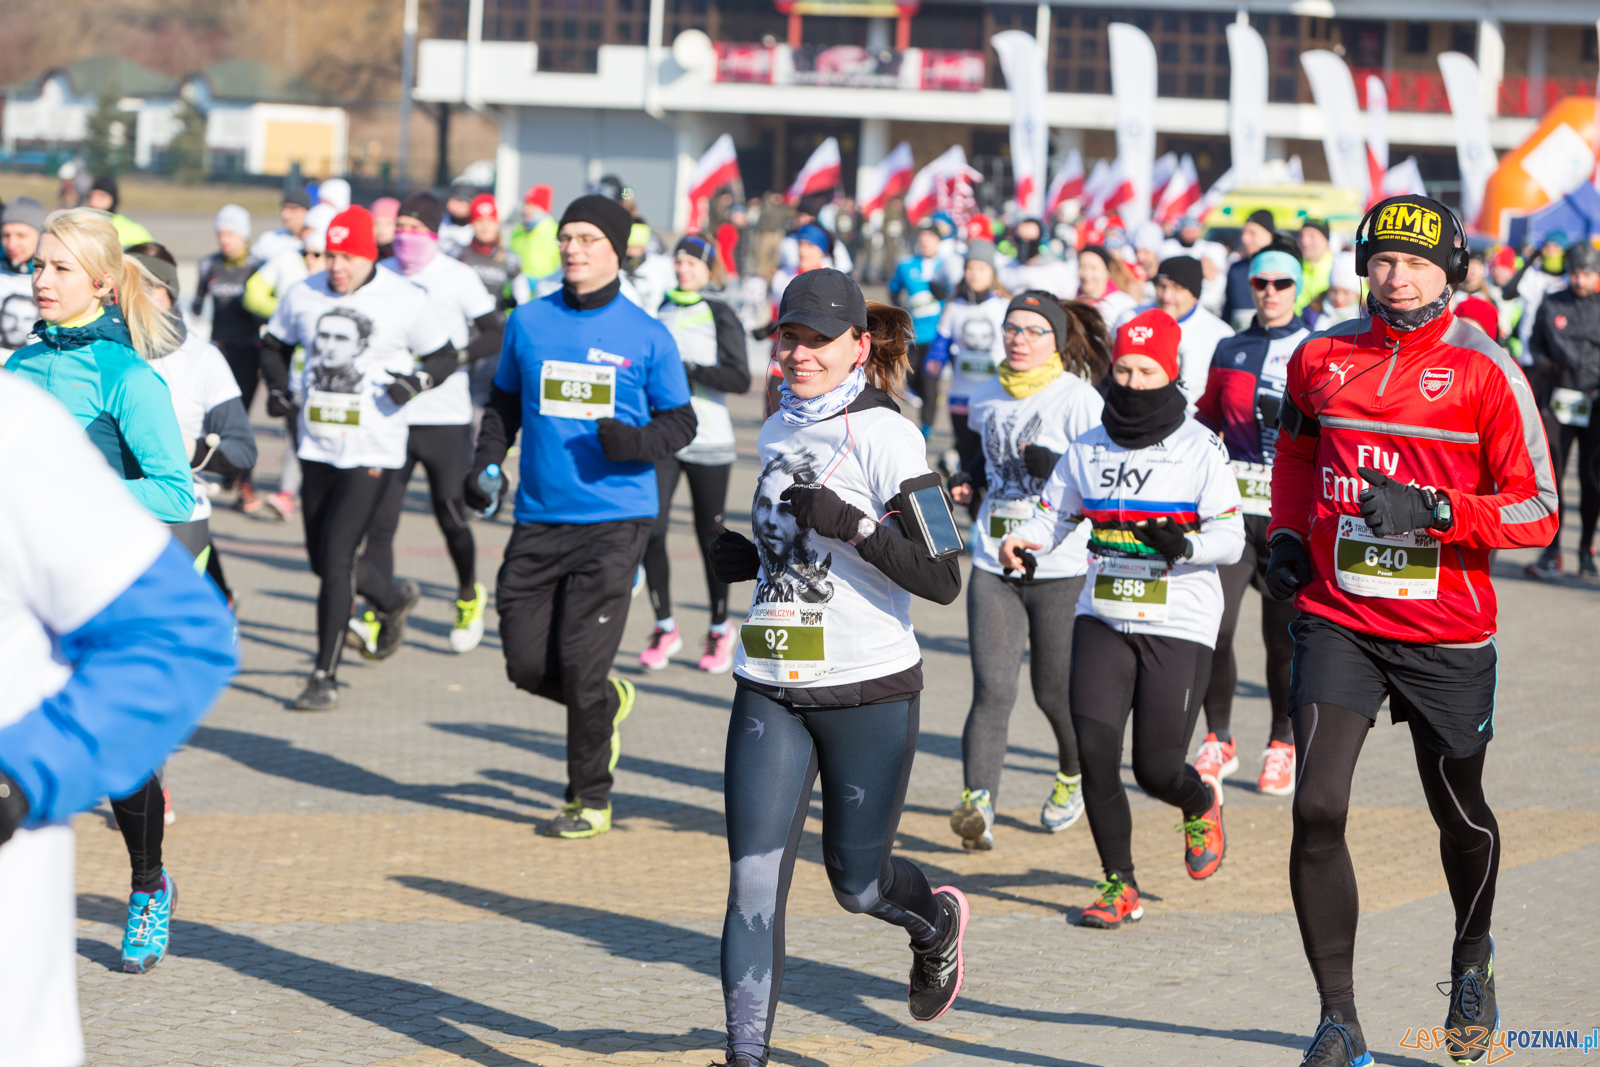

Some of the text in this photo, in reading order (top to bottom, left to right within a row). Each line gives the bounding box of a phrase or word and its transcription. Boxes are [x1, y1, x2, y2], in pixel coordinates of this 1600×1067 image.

[1377, 206, 1438, 240] RMG
[1425, 371, 1449, 379] Arsenal
[561, 381, 593, 400] 683
[1357, 444, 1400, 476] Fly
[1100, 462, 1153, 495] sky
[1365, 546, 1408, 570] 640
[1112, 578, 1146, 598] 558
[765, 628, 789, 651] 92
